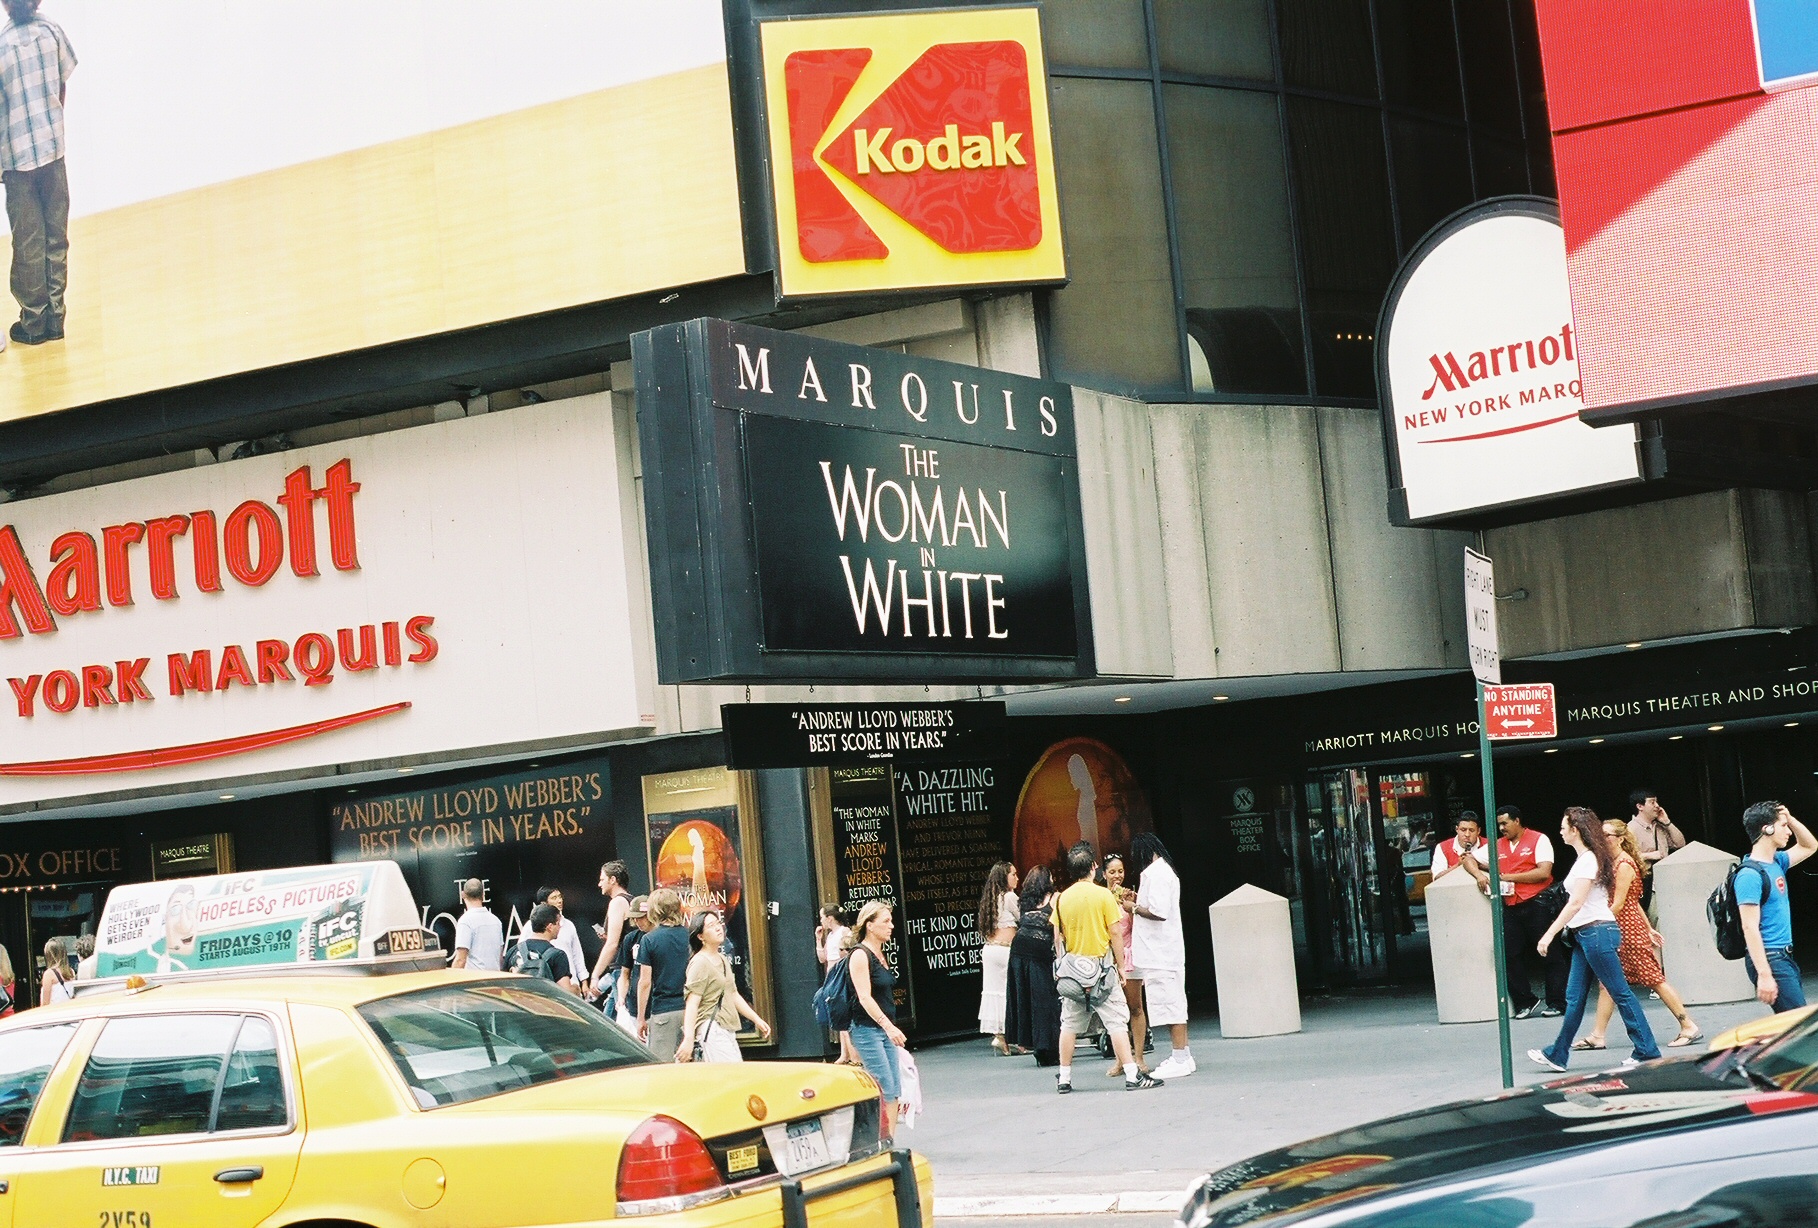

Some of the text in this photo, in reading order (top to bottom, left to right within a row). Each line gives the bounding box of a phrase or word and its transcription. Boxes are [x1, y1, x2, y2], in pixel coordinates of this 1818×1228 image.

[854, 121, 1026, 175] Kodak
[1422, 323, 1574, 400] Marriot
[735, 343, 1057, 436] MARQUIS
[1404, 380, 1582, 430] NEW YORK MARQ
[899, 444, 939, 478] THE
[819, 461, 1009, 550] WOMAN
[920, 547, 935, 567] IN
[839, 555, 1008, 639] WHITE
[7, 615, 440, 718] YORK MARQUIS
[1484, 689, 1548, 702] NO STANDING
[1568, 701, 1641, 721] MARQUIS
[1647, 692, 1722, 712] THEATER
[1728, 687, 1765, 704] AND
[858, 710, 897, 729] LLOYD
[900, 710, 953, 728] WEBBER'S
[1492, 704, 1542, 717] ANYTIME
[809, 734, 837, 752] BEST
[841, 732, 882, 751] SCORE
[886, 731, 900, 750] IN
[1305, 733, 1374, 752] MARRIOTT
[1381, 724, 1449, 743] MARQUIS
[834, 766, 885, 778] MARQUIS THEATRE
[918, 767, 994, 790] DAZZLING
[655, 777, 690, 788] MARQUIS
[433, 787, 499, 819] LLOYD
[503, 772, 602, 810] WEBBER'S
[905, 791, 988, 815] WHITE HIT.
[855, 805, 890, 818] WOMAN
[845, 818, 881, 832] IN WHITE
[1230, 817, 1262, 828] MARQUIS
[1231, 827, 1263, 836] THEATER
[360, 829, 400, 857] BEST
[408, 821, 475, 851] SCORE
[482, 816, 504, 845] IN
[850, 831, 879, 844] MARKS
[914, 832, 931, 843] AND
[1239, 835, 1256, 844] BOX
[159, 844, 209, 858] MARQUIS THEATRE
[844, 842, 887, 858] ANDREW
[922, 844, 959, 857] DELIVERED
[1237, 844, 1261, 853] OFFICE
[39, 847, 122, 875] OFFICE
[851, 857, 883, 872] LLOYD
[934, 857, 974, 870] ROMANTIC
[846, 870, 890, 886] WEBBER'S
[199, 879, 355, 922] HOPELESS PICTURES
[454, 878, 491, 905] TE
[849, 884, 893, 899] RETURN TO
[951, 886, 961, 897] AS
[108, 904, 160, 924] HOLLYWOOD
[109, 898, 139, 913] WHERE
[934, 899, 979, 913] TO PRECISEL
[107, 916, 150, 935] GETS EVEN
[906, 913, 975, 935] THE KIND OF
[107, 928, 143, 945] WEIRDER
[200, 933, 261, 953] FRIDAYS
[377, 942, 388, 951] OFF
[391, 930, 420, 951] 2V59
[922, 931, 986, 952] LLOYD WEBB
[199, 941, 291, 962] STARTS AUGUST 19TH
[927, 949, 983, 970] WRITES BES
[729, 1150, 741, 1160] BEST
[103, 1166, 159, 1186] N.Y.C. TAXI
[99, 1211, 151, 1228] 2V59
